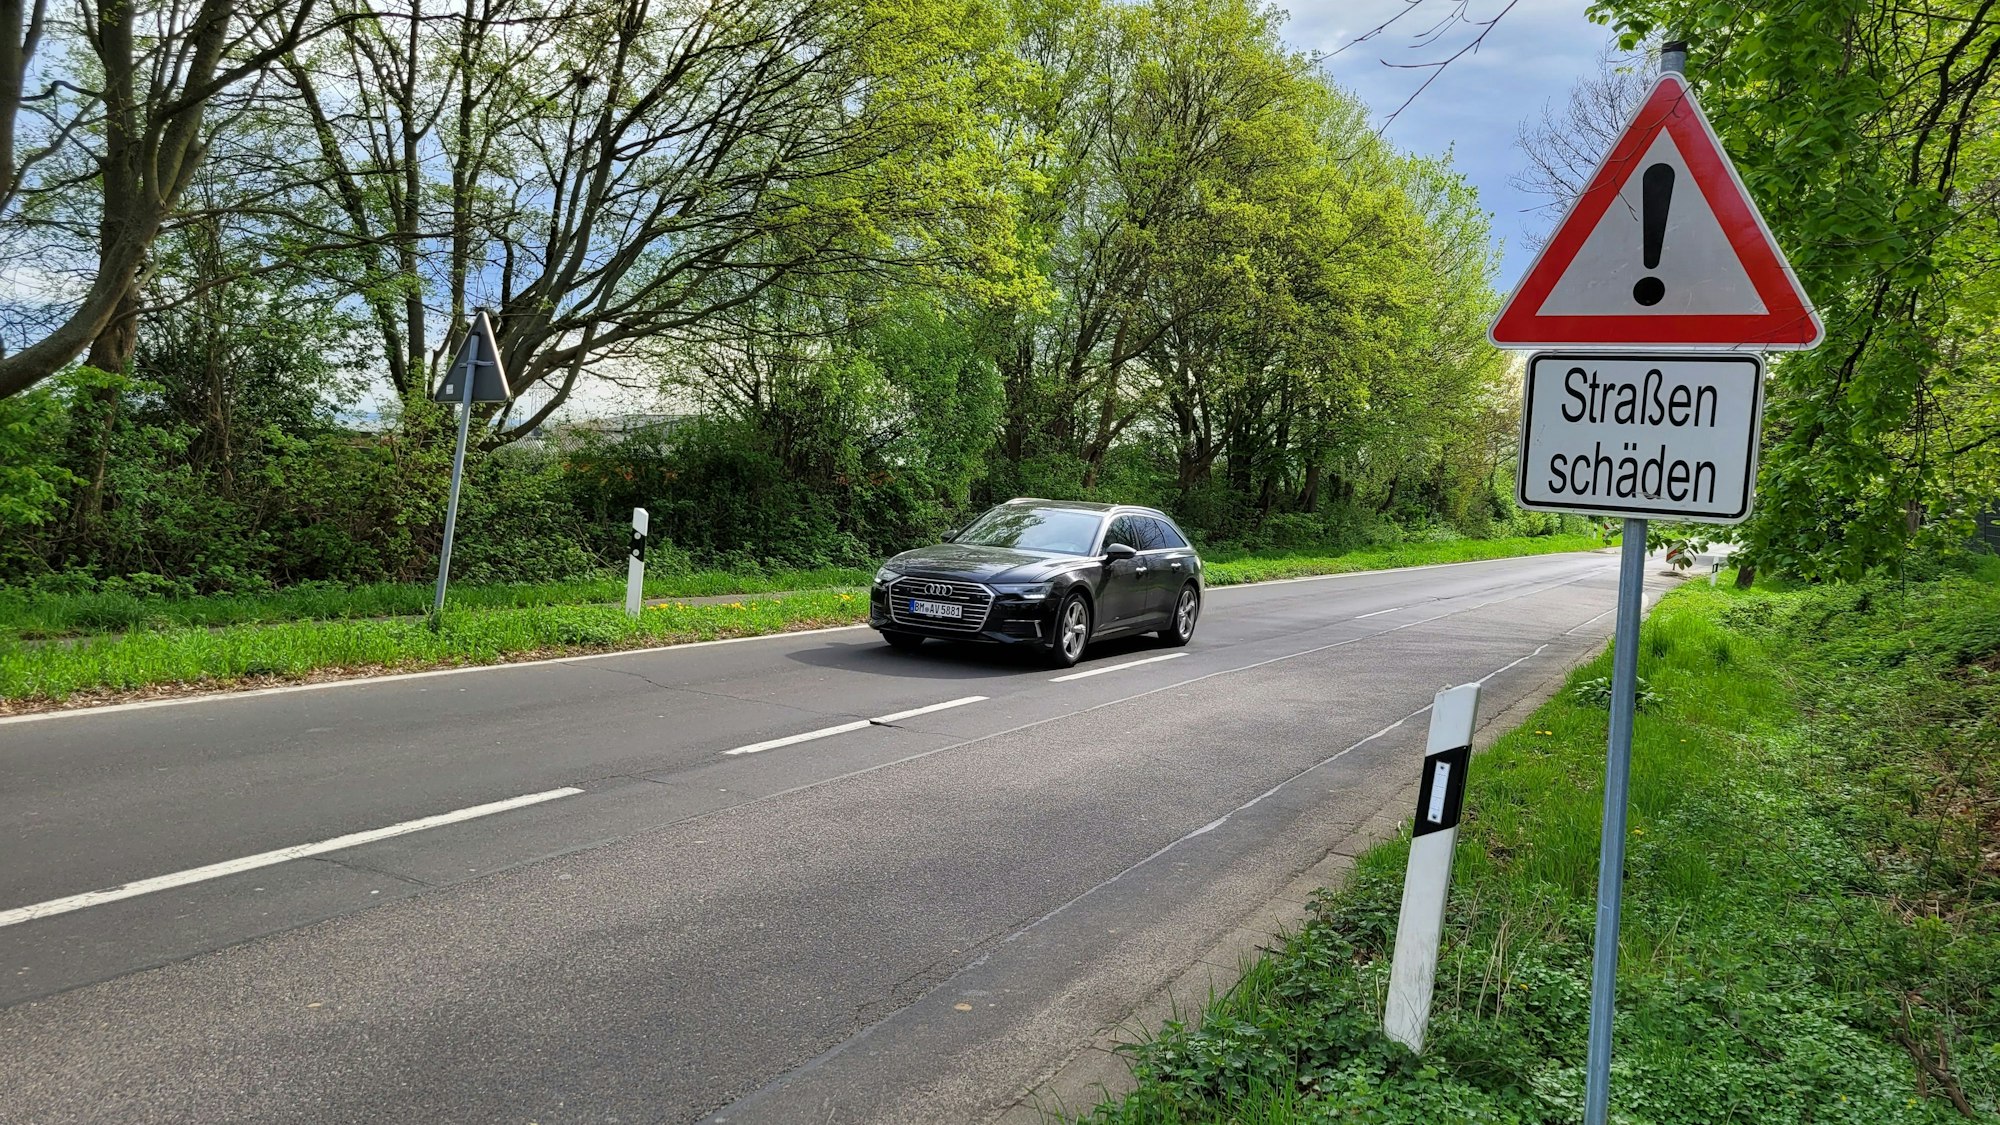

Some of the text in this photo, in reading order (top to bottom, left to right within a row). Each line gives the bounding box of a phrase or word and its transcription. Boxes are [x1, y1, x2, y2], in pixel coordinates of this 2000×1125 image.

[1561, 367, 1718, 427] Straßen
[1548, 441, 1716, 504] schäden
[914, 602, 960, 617] BM AV 5881
